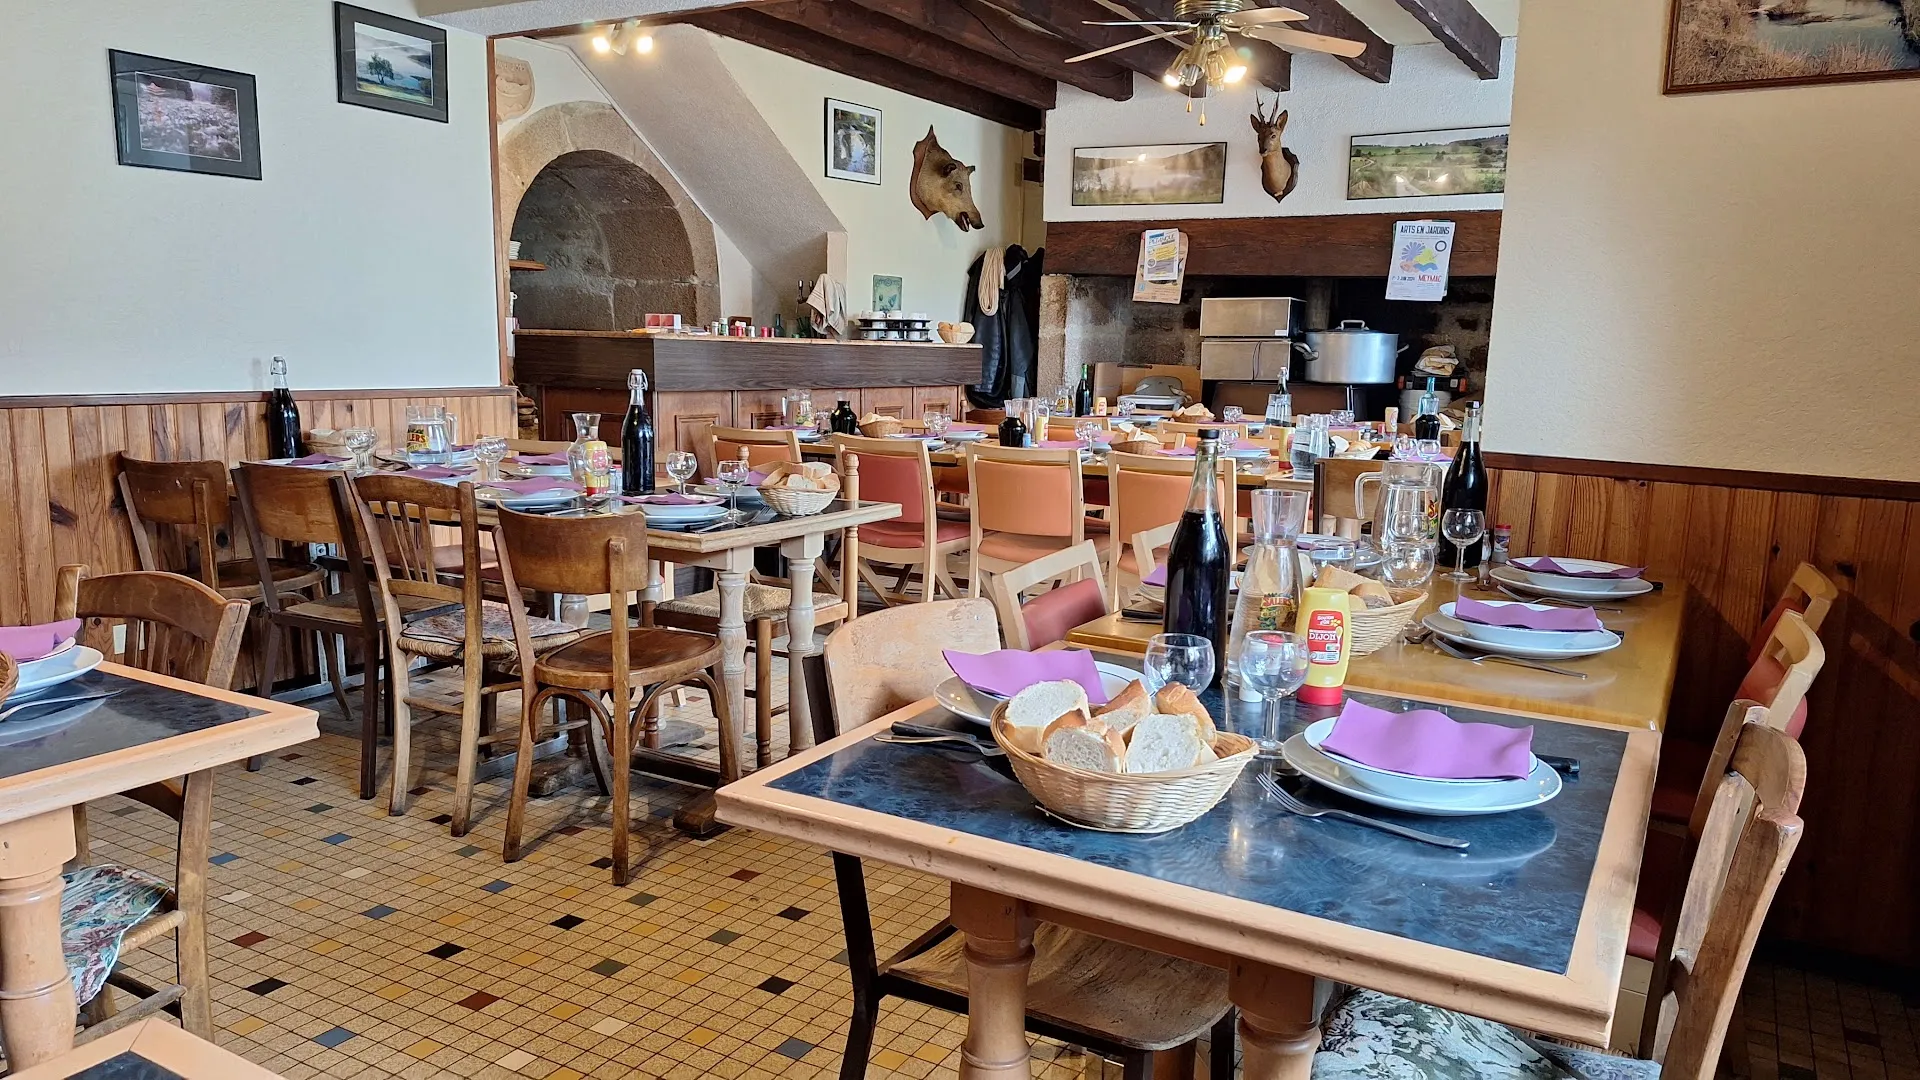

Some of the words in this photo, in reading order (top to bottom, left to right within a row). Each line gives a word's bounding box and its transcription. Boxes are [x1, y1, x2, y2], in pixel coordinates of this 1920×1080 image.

[1400, 225, 1416, 234] ARTS
[1416, 225, 1425, 234] EN
[1425, 226, 1450, 235] JARDINS
[1418, 274, 1442, 282] MEYMAC
[1309, 632, 1336, 641] DIJON
